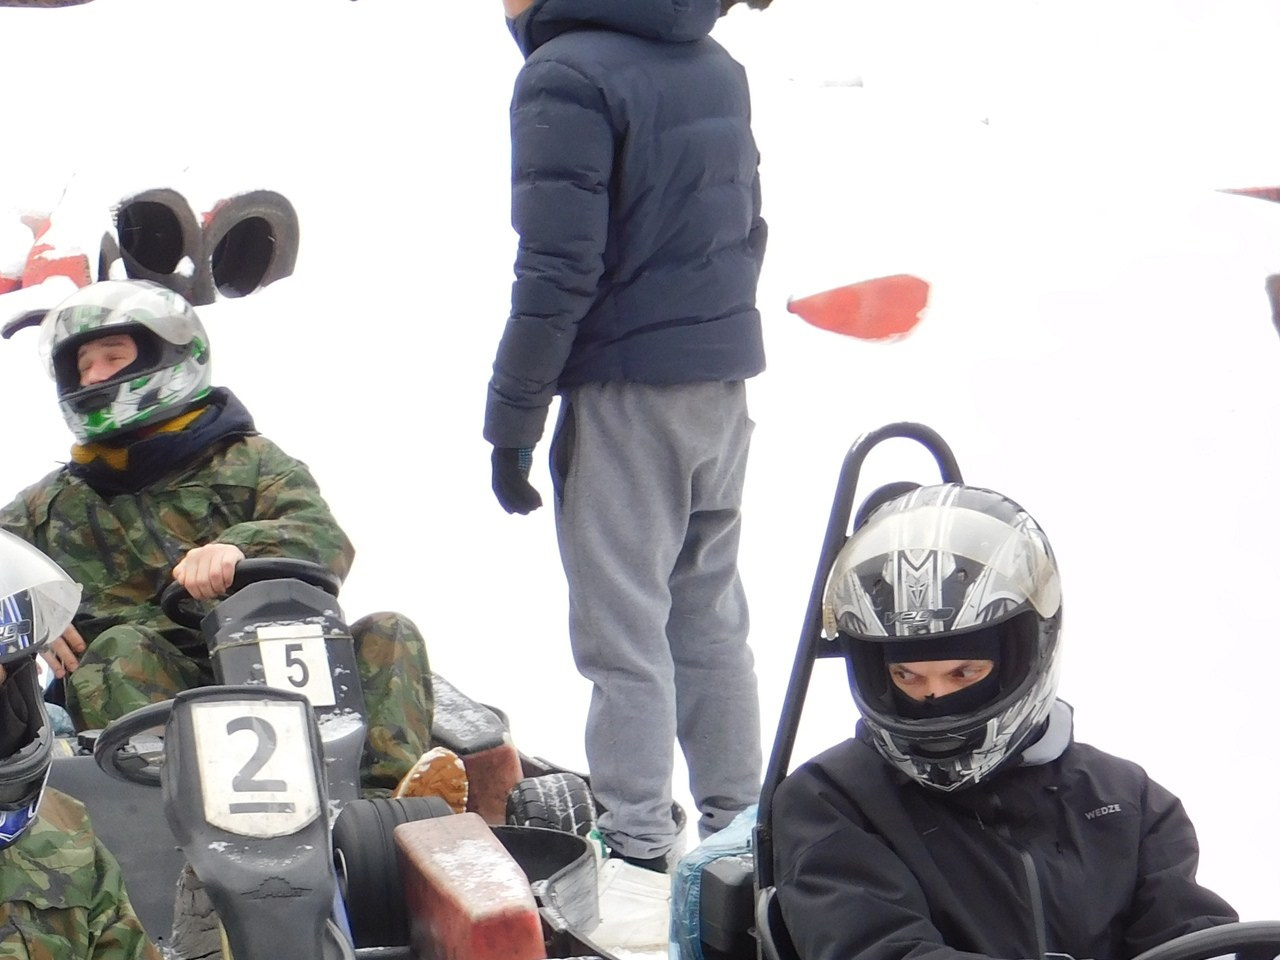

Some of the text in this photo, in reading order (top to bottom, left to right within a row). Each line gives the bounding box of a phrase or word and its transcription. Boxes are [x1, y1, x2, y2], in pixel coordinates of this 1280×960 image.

[284, 642, 310, 688] 5
[226, 715, 288, 793] 2
[1084, 803, 1122, 820] WEDZE
